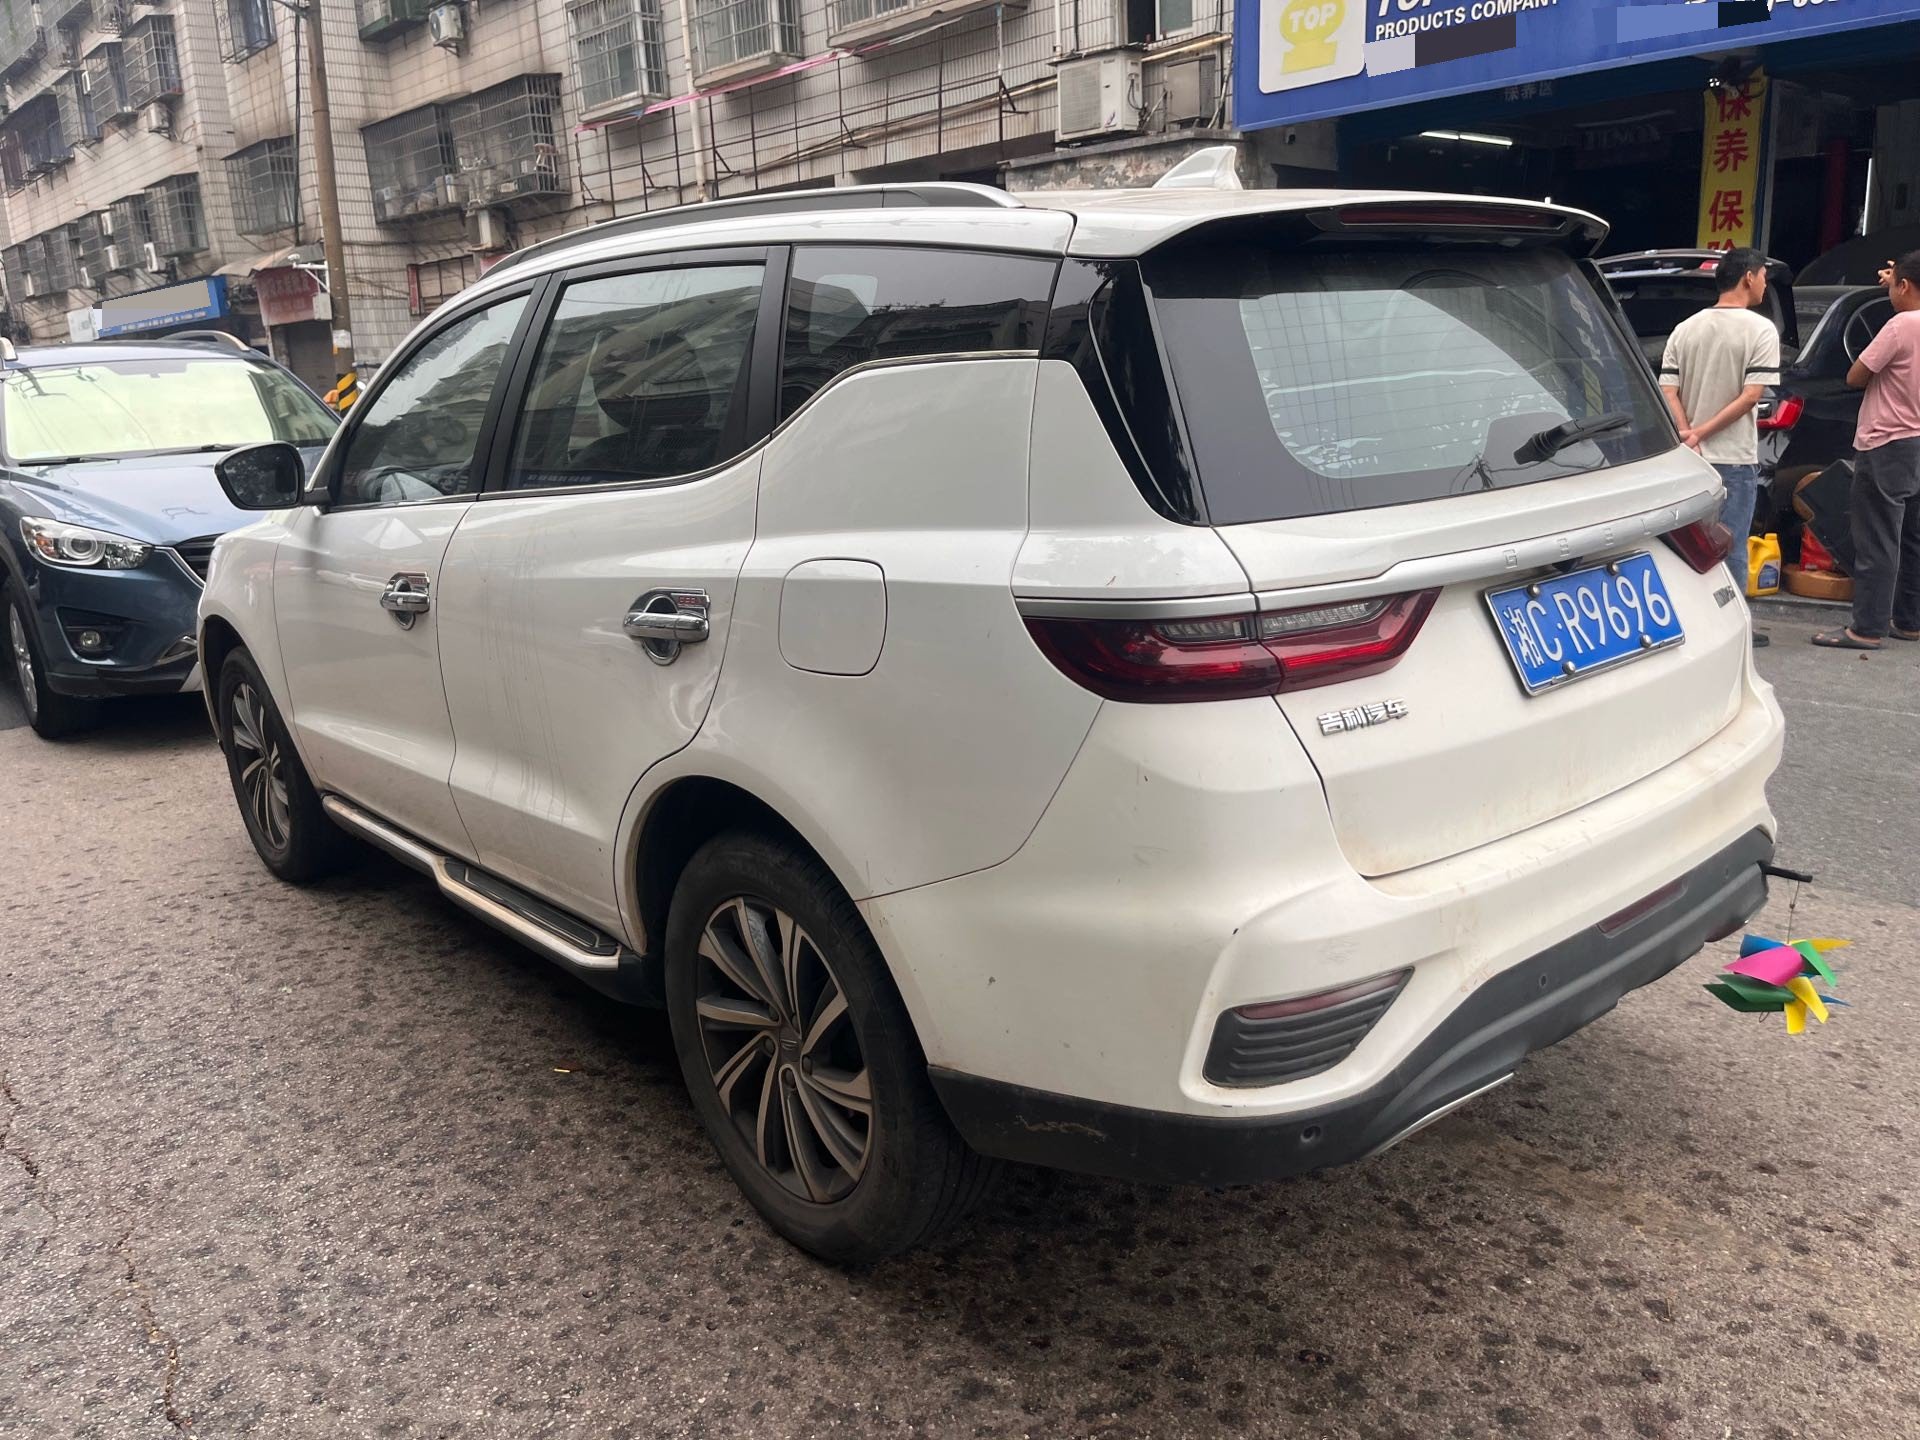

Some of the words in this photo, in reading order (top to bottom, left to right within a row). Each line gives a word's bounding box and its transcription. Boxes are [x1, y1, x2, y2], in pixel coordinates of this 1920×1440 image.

[1289, 3, 1337, 33] TOP
[1375, 6, 1466, 41] PRODUCTS
[1316, 698, 1409, 736] 吉利汽车
